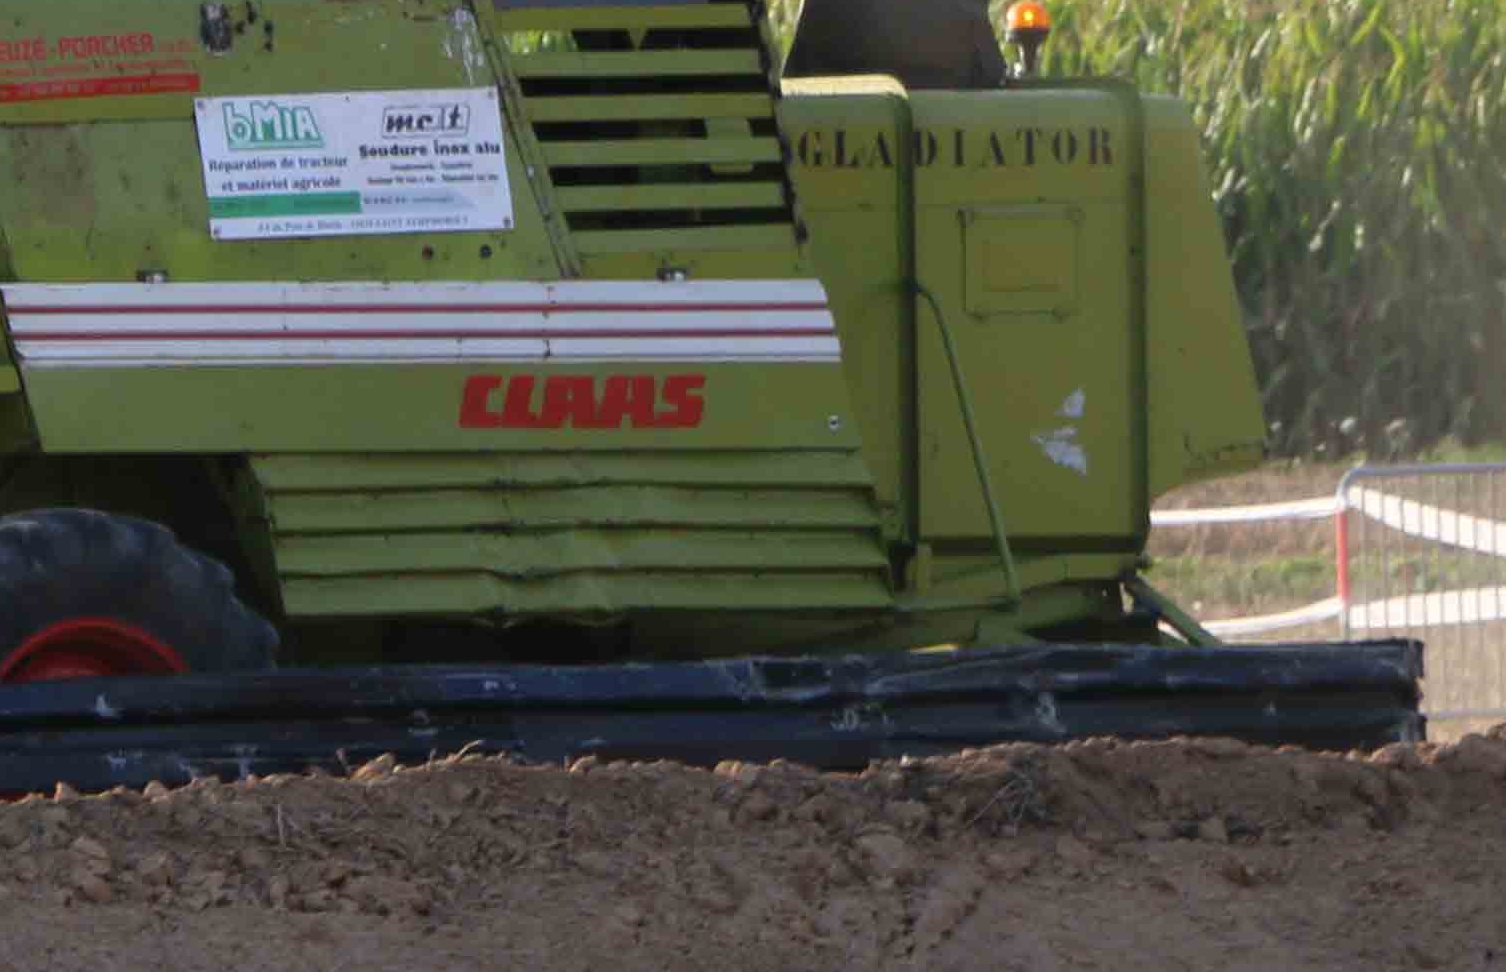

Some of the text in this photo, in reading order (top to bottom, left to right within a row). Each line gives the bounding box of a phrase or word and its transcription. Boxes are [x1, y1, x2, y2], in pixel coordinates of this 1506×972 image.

[359, 142, 428, 159] Soudure
[475, 140, 501, 155] alu
[796, 126, 1114, 168] GLADIATOR
[281, 156, 296, 169] de
[298, 155, 348, 168] tracteur
[292, 176, 342, 191] agricole
[459, 374, 707, 429] CLAAS
